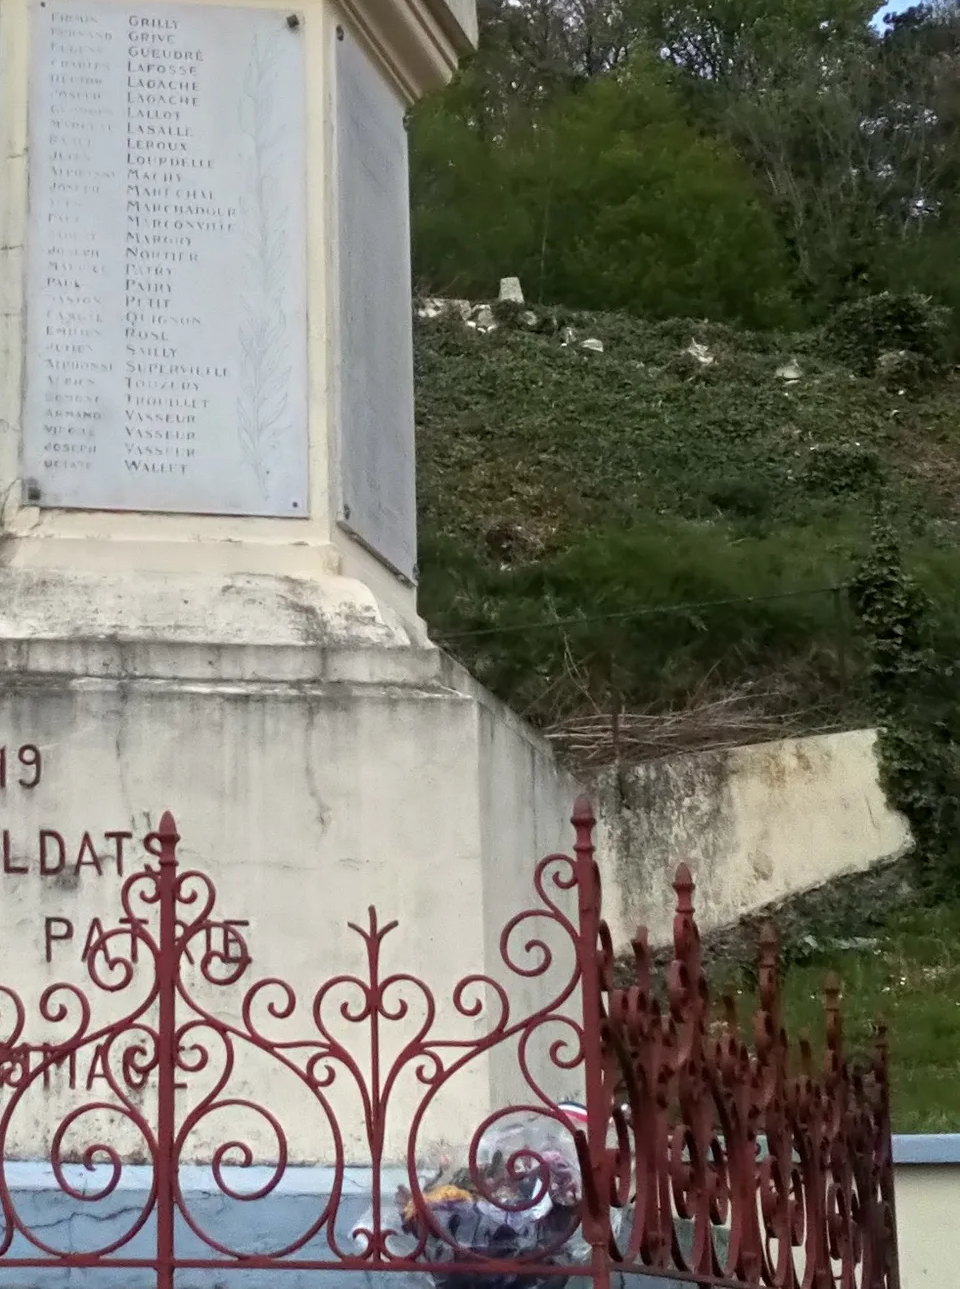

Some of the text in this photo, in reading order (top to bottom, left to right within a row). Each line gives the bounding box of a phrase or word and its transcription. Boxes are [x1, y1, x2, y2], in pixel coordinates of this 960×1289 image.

[128, 15, 181, 29] GRILLY
[128, 31, 176, 44] GRIVE
[127, 60, 197, 75] LAFOSSE
[127, 138, 189, 151] LEROUX
[125, 410, 196, 424] VASSEUR
[45, 916, 252, 965] PATRIE
